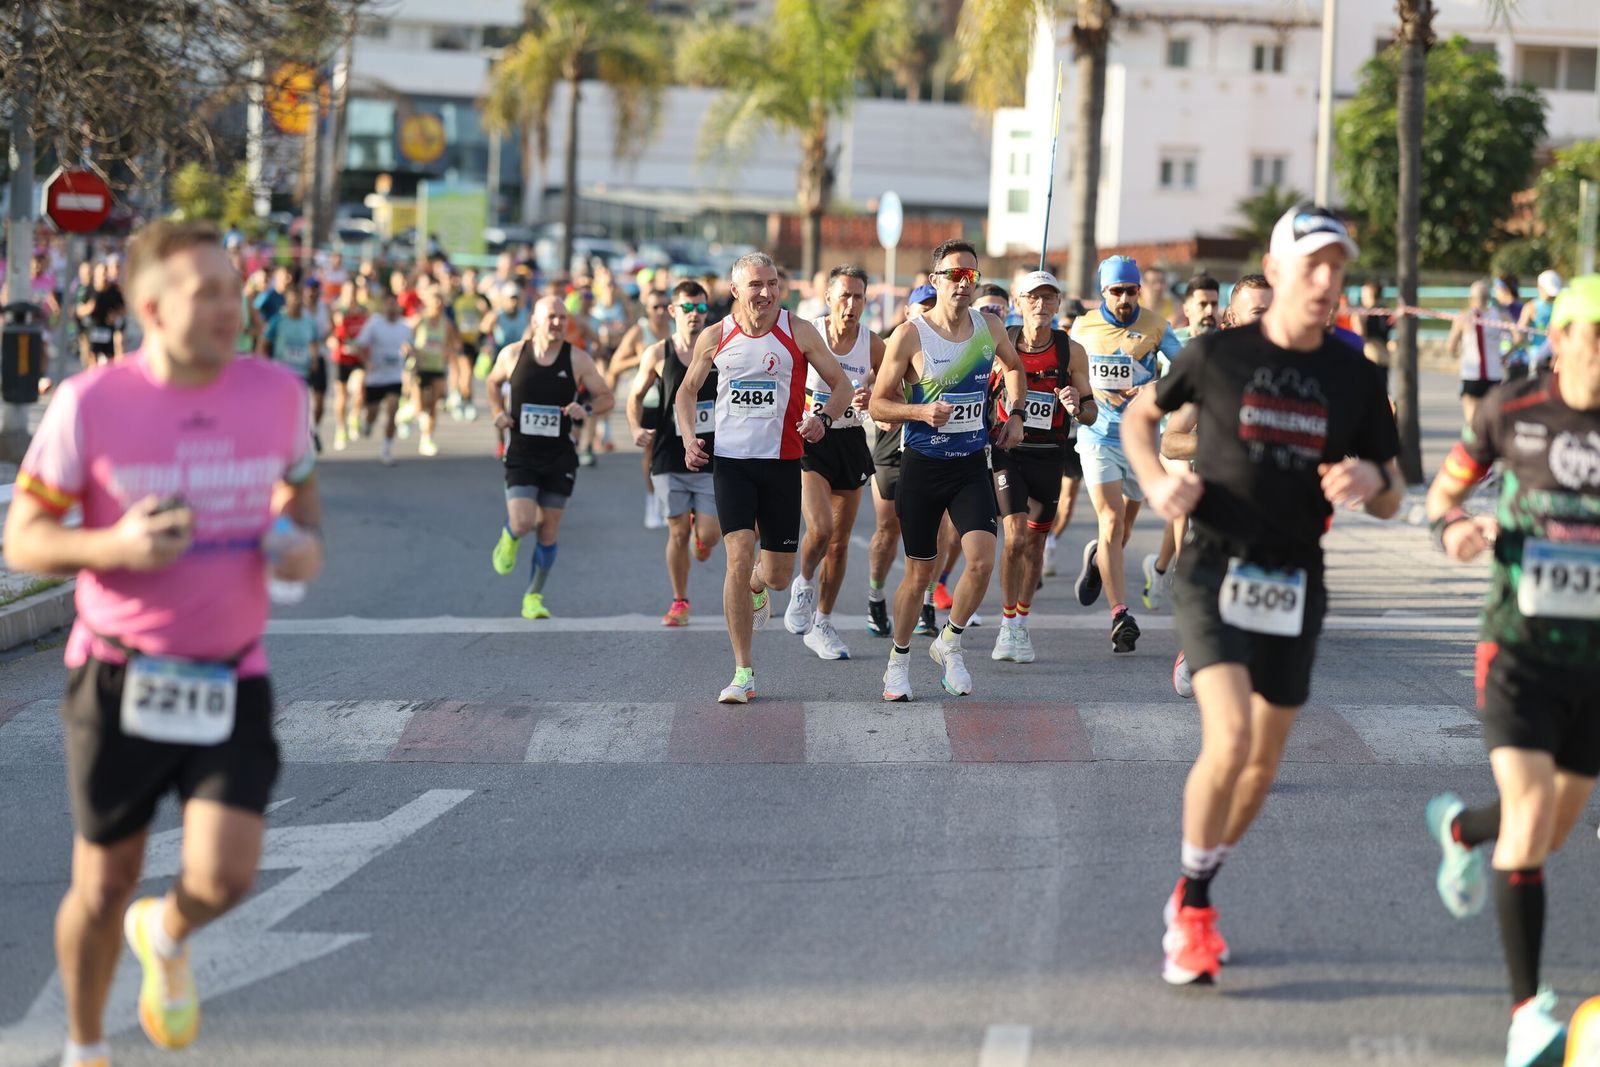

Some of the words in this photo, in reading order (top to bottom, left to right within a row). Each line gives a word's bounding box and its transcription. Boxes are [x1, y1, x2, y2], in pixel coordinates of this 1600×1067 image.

[1092, 364, 1130, 378] 1948
[731, 390, 775, 405] 2484
[813, 403, 854, 418] 26
[953, 403, 981, 421] 210
[1024, 401, 1051, 417] 708
[525, 413, 558, 427] 1732
[1230, 582, 1297, 614] 1509
[136, 680, 226, 717] 2210
